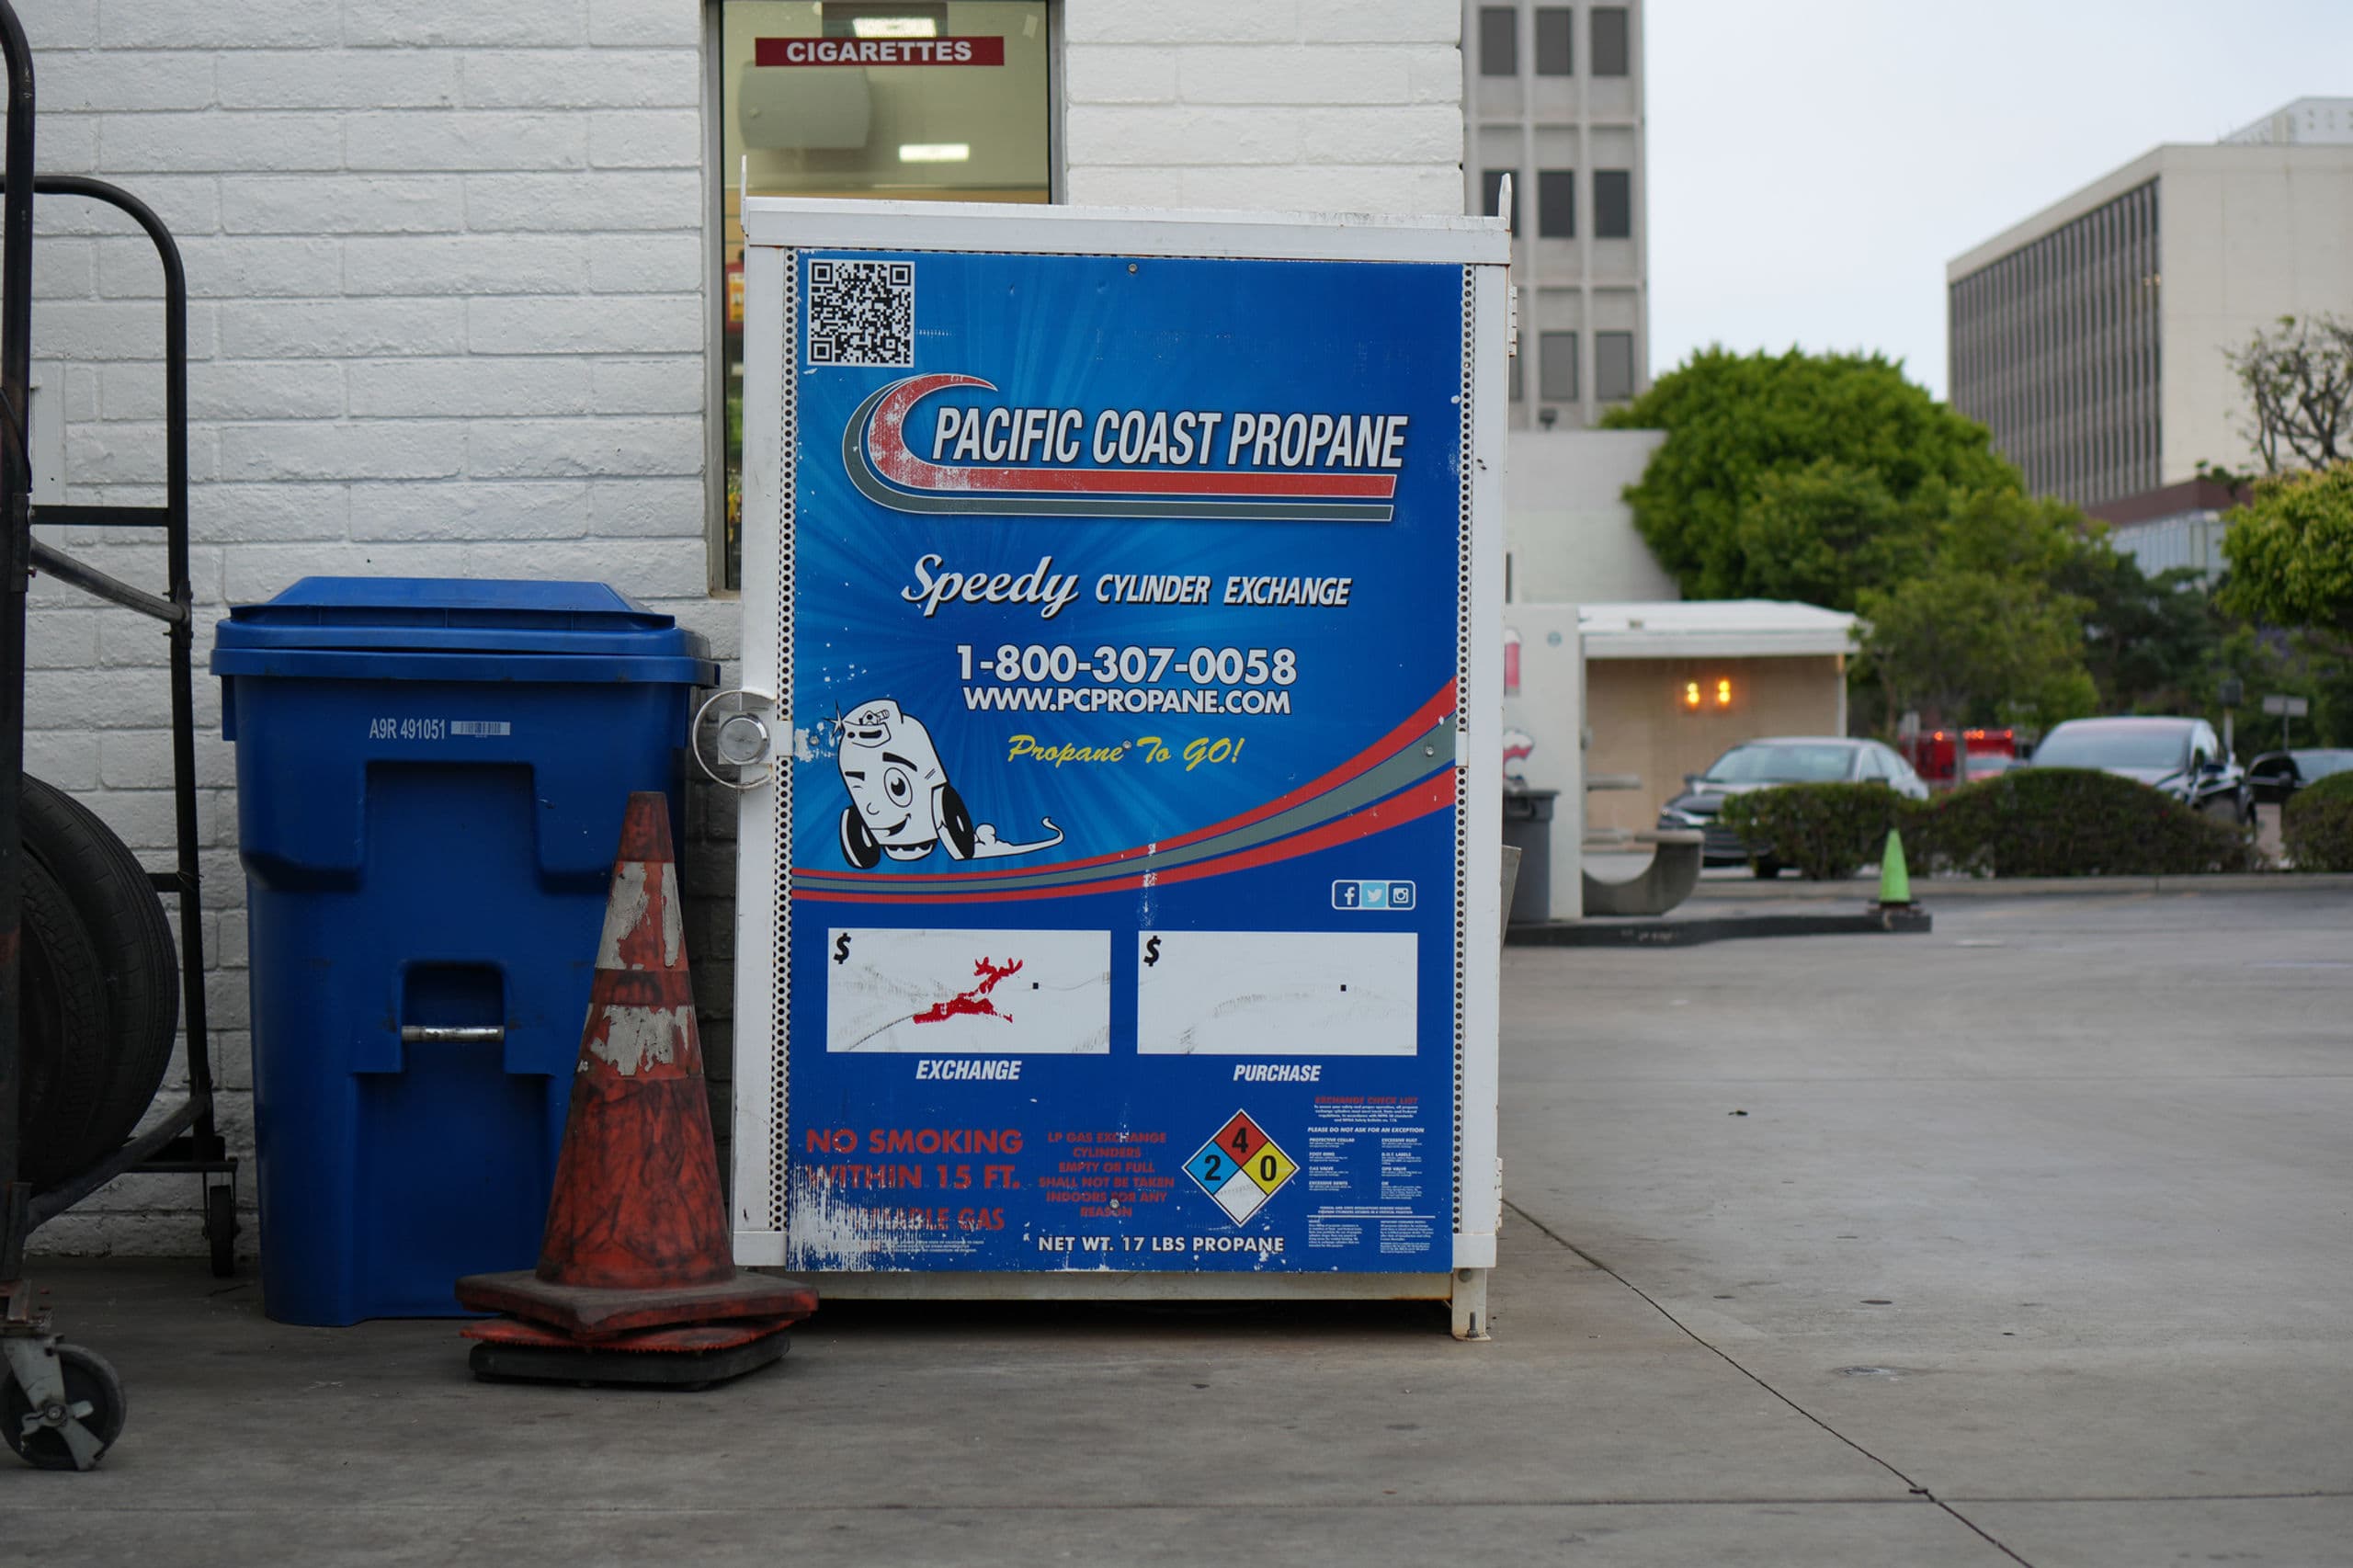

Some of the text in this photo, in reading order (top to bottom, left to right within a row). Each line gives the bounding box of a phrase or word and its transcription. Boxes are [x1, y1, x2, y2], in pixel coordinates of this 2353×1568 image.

[787, 41, 972, 62] CIGARETTES
[931, 406, 1409, 470] PACIFIC COAST PROPANE
[901, 553, 1353, 619] Speedy CYLINDER EXCHANGE
[956, 644, 1298, 687] 1-800-307-0058
[962, 687, 1292, 715] WWW.PCPROPANE.COM
[369, 718, 446, 740] A9R 491051
[1007, 735, 1245, 771] Propane To GO!
[915, 1060, 1022, 1082] EXCHANGE
[1233, 1063, 1322, 1083] PURCHASE
[805, 1129, 1024, 1153] NO SMOKING
[1048, 1132, 1167, 1143] LP GAS EXCHANGE
[1232, 1127, 1249, 1153] 4
[1073, 1147, 1142, 1158] CYLINDERS
[805, 1165, 1021, 1189] WITHIN 15 FT.
[1059, 1162, 1154, 1173] EMPTY OR FULL
[1204, 1154, 1222, 1181] 2
[1260, 1155, 1278, 1182] 0
[1039, 1176, 1175, 1187] SHALL NOT BE TAKEN
[1046, 1191, 1167, 1202] INDOORS FOR ANY
[958, 1207, 1006, 1231] GAS
[1080, 1206, 1132, 1217] REASON
[1038, 1236, 1285, 1254] NET WT. 17 LBS PROPANE
